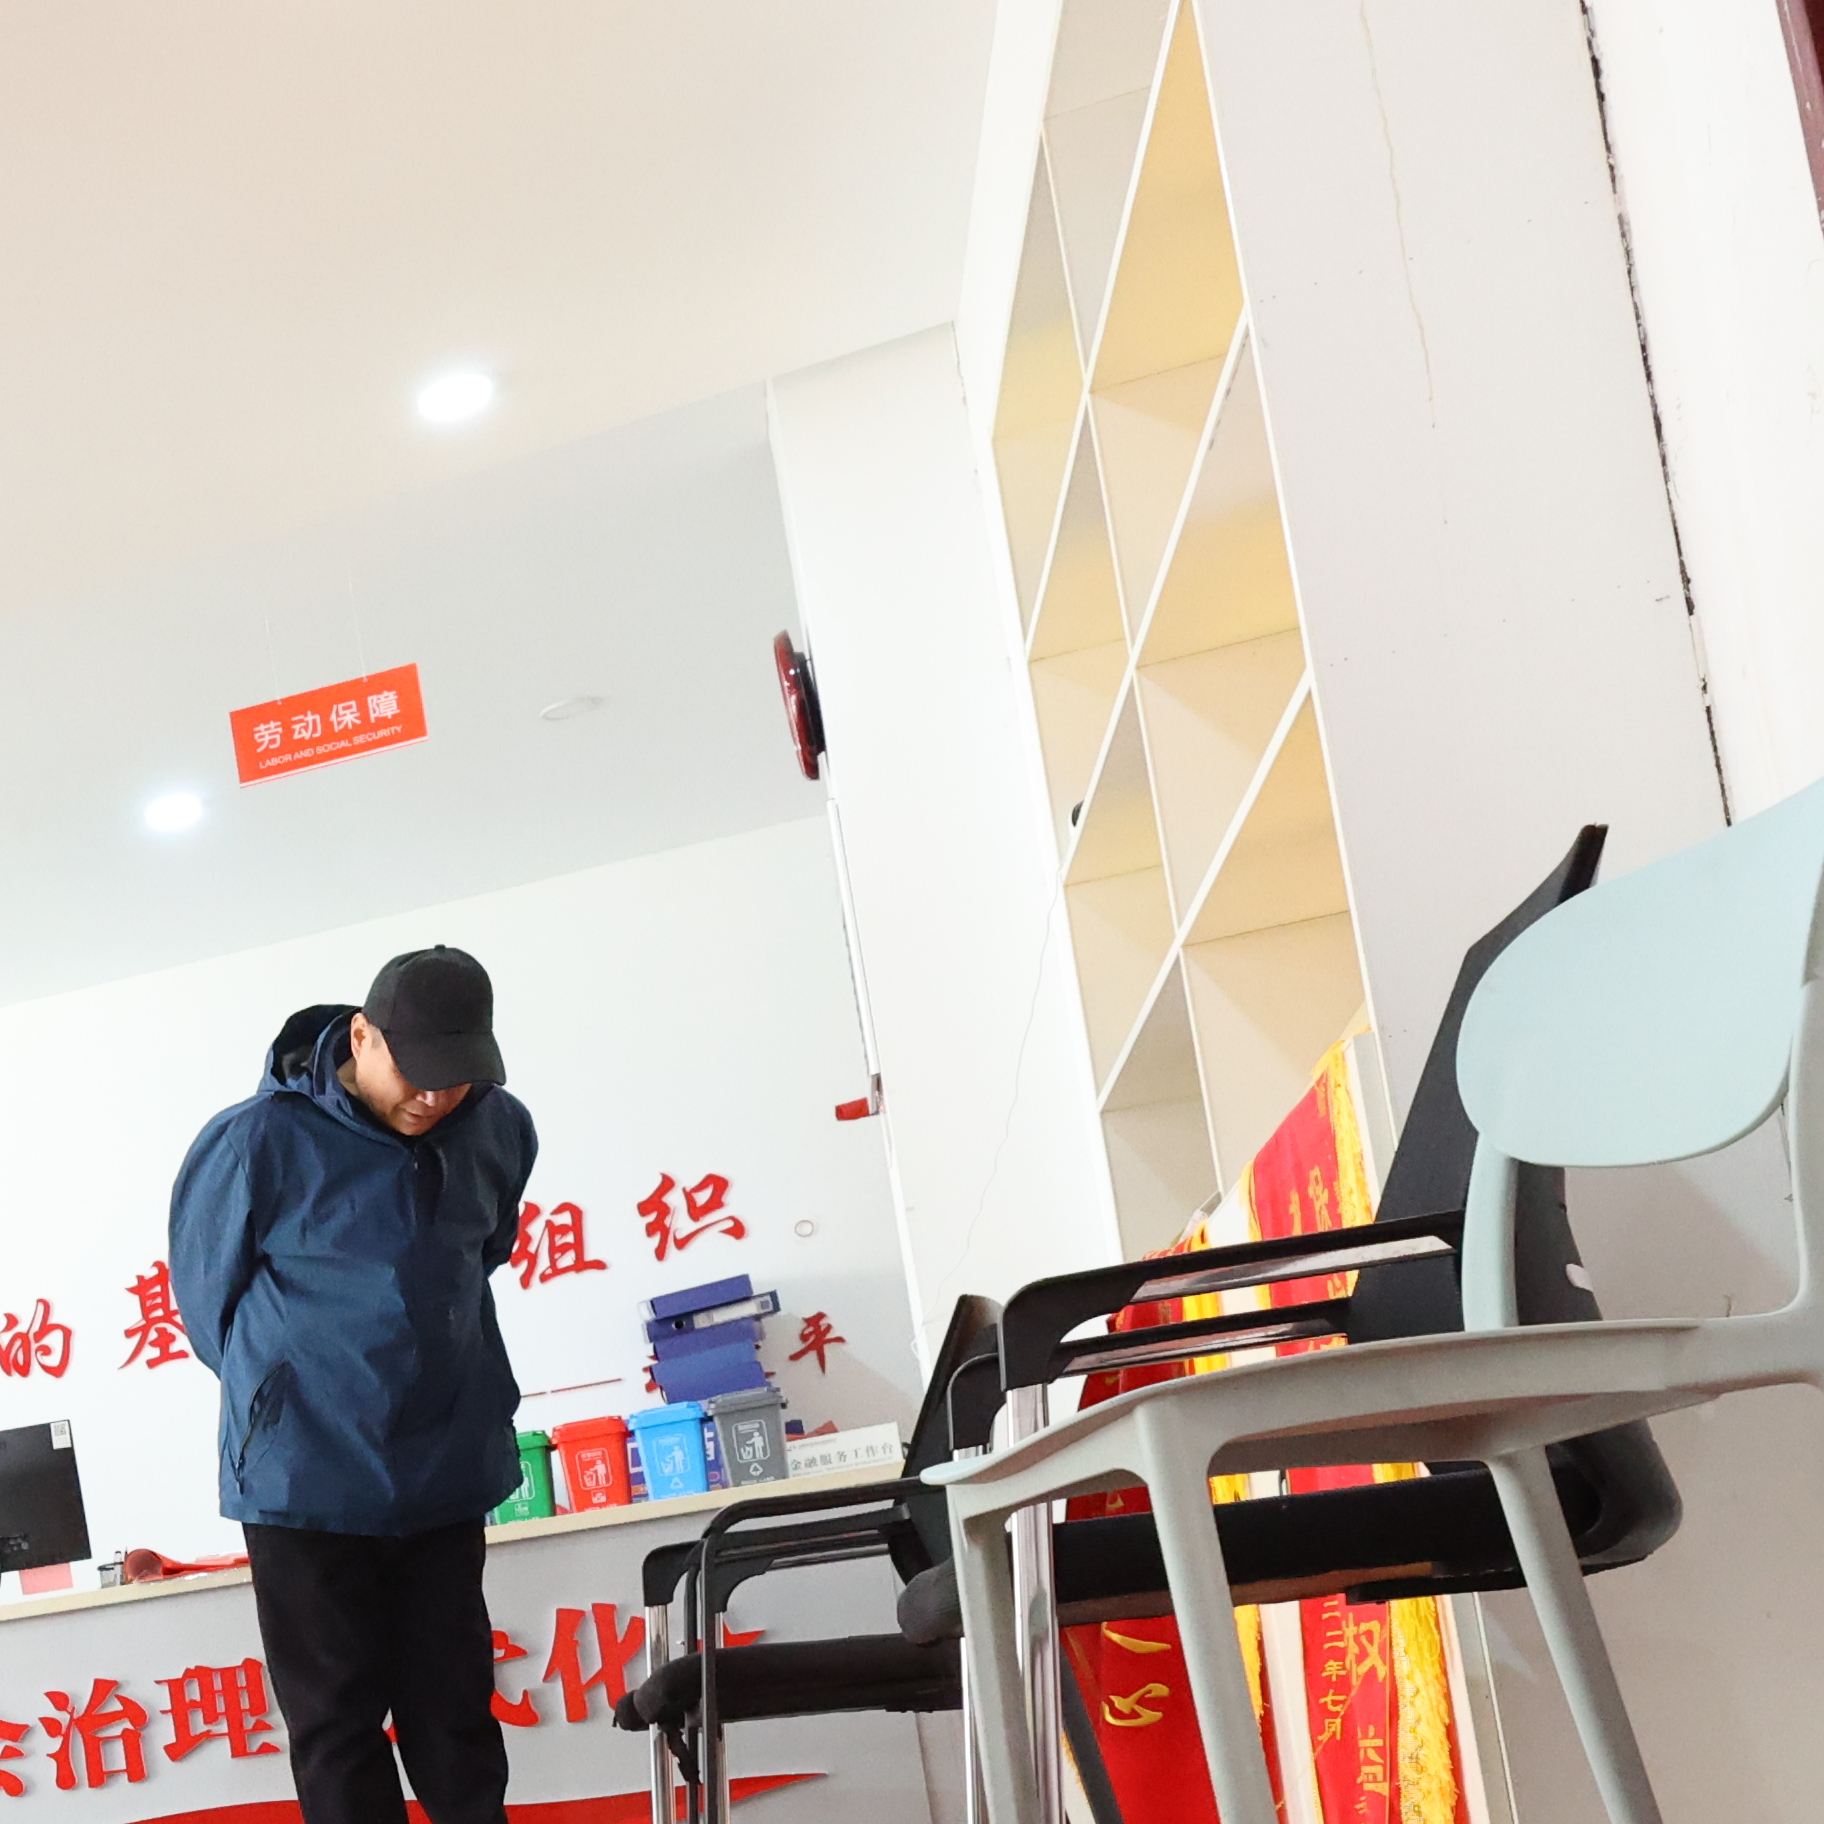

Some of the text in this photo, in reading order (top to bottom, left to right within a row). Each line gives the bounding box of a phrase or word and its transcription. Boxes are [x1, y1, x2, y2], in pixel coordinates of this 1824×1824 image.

[253, 690, 401, 753] 劳动保障
[259, 725, 403, 770] LABOR AND SOCIAL SECURITY
[791, 1442, 893, 1471] 金融服务工作台
